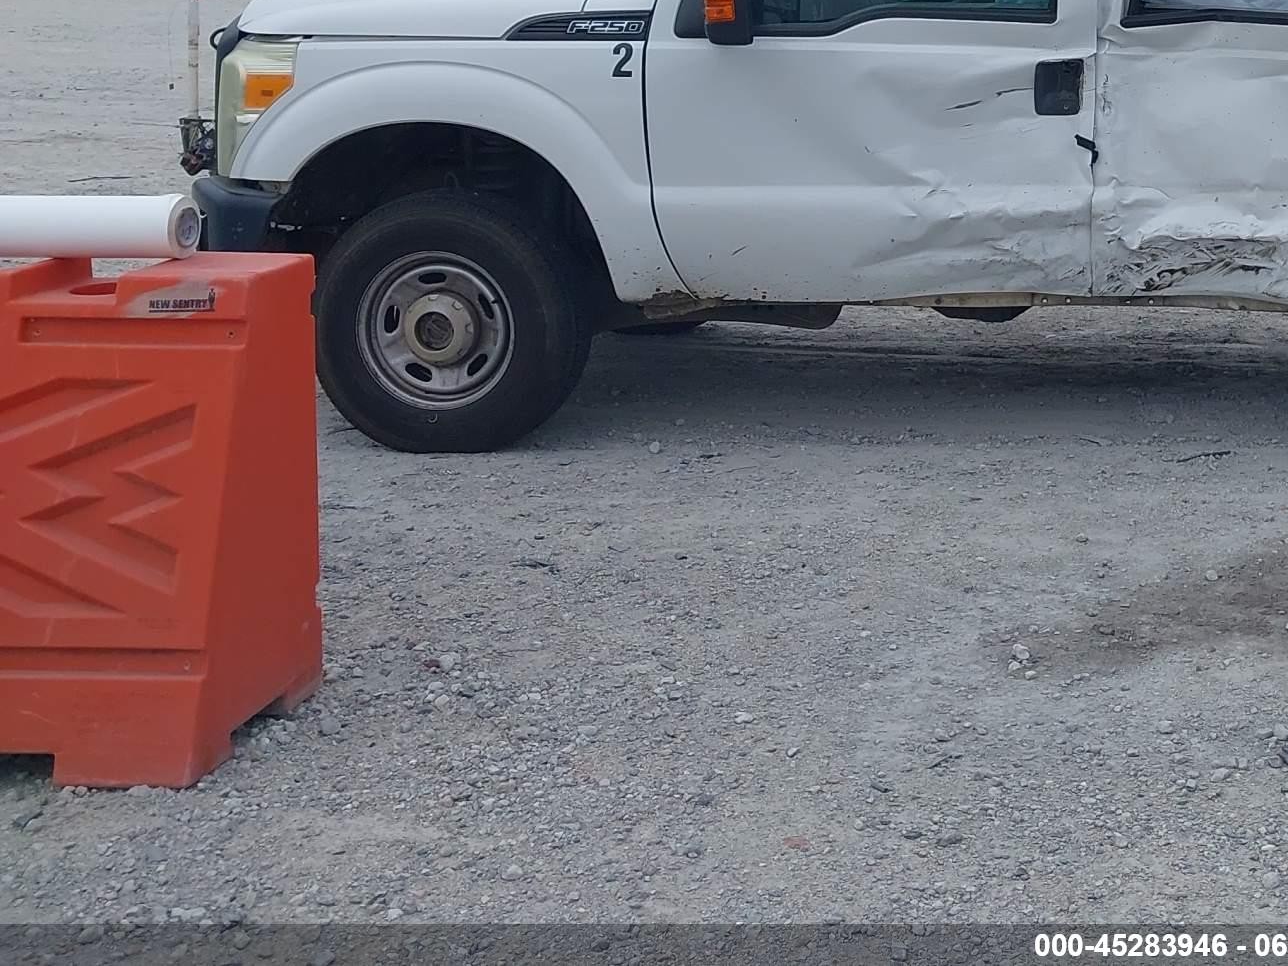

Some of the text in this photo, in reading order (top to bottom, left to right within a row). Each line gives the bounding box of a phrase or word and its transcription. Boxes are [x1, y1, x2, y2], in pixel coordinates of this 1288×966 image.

[612, 43, 633, 78] 2
[149, 298, 208, 309] NEW SENTRY
